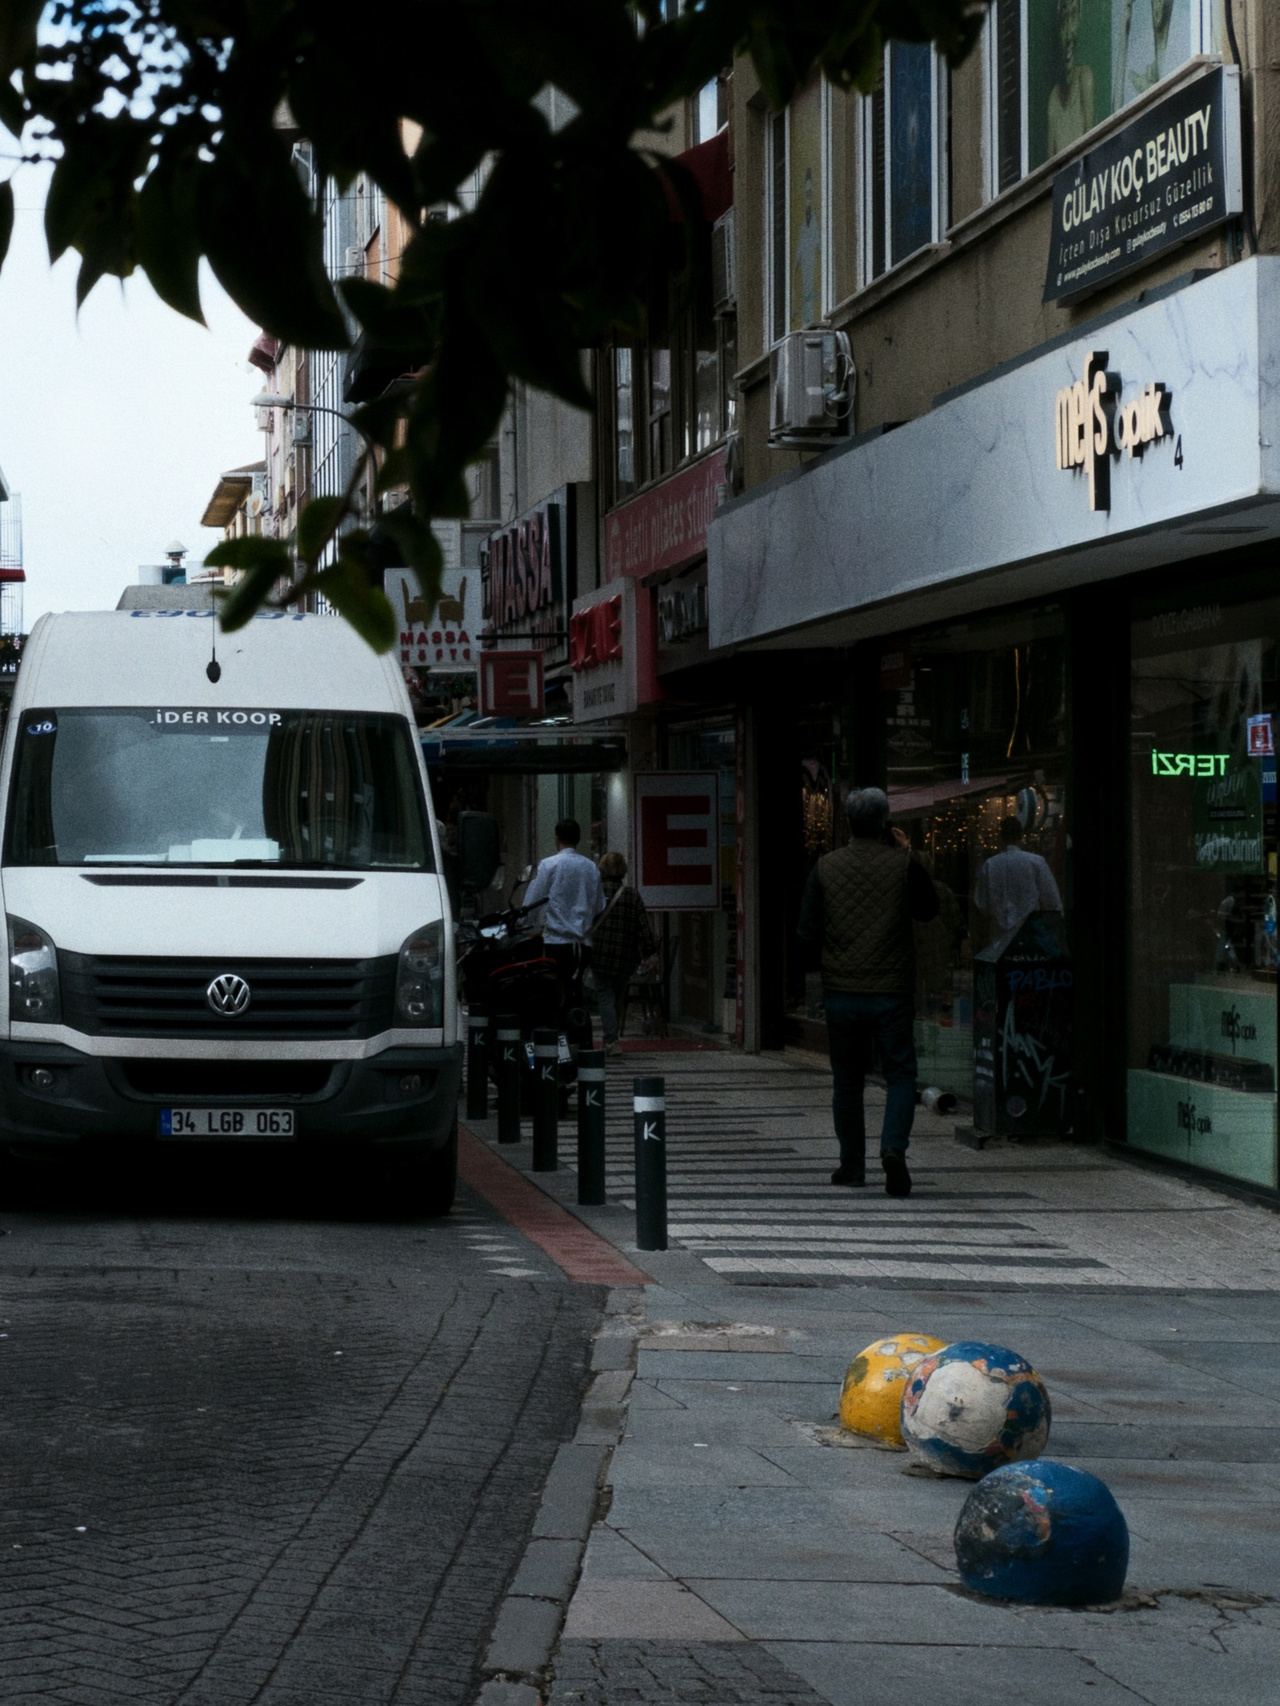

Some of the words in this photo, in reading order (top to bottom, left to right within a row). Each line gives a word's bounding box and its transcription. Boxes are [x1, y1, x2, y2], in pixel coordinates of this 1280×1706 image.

[1062, 169, 1109, 232] GÜLAY
[1111, 148, 1144, 203] KOÇ
[1145, 104, 1212, 184] BEAUTY
[1089, 226, 1111, 250] Dışa
[1114, 197, 1161, 236] Kusursuz
[1165, 162, 1213, 206] Güzellik
[490, 505, 554, 630] MASSA
[400, 631, 470, 645] MASSA
[493, 660, 530, 706] E
[35, 722, 53, 732] 10
[217, 711, 282, 726] KOOP.
[642, 796, 712, 885] E
[504, 1047, 517, 1062] K
[542, 1064, 556, 1081] K
[586, 1089, 602, 1107] K
[172, 1111, 195, 1132] 34
[208, 1111, 244, 1133] LGB
[257, 1112, 293, 1133] 063
[643, 1121, 662, 1141] K
